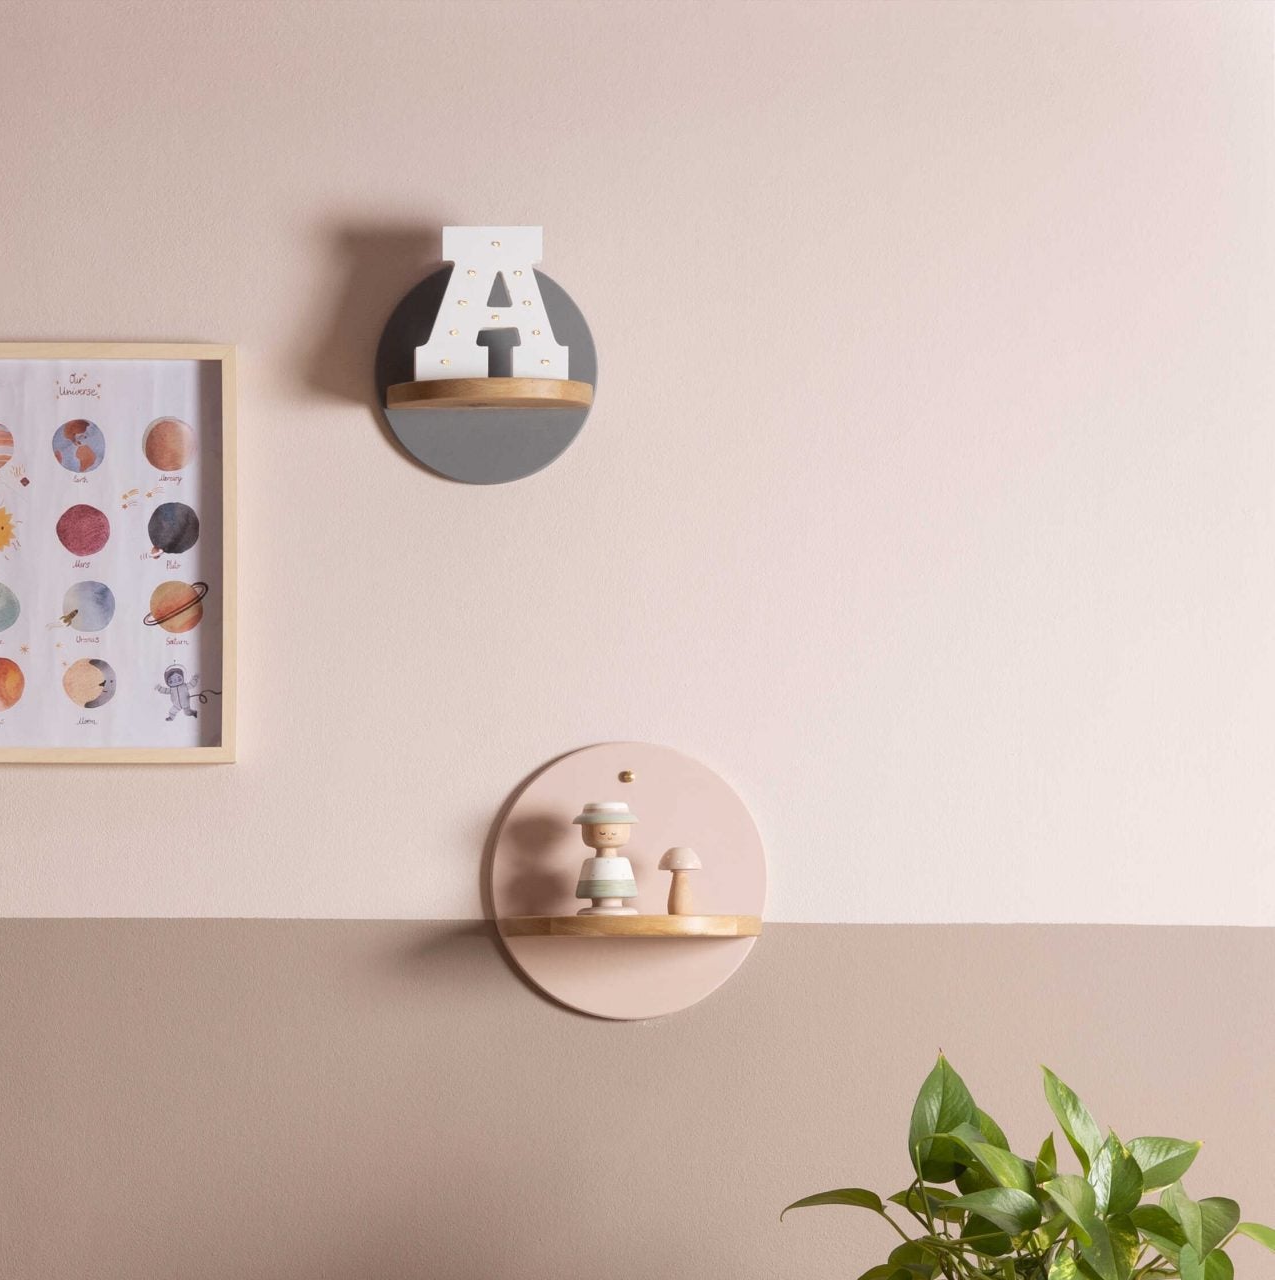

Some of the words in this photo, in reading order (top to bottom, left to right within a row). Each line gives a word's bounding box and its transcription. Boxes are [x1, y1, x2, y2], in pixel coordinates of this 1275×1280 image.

[414, 226, 569, 381] A
[69, 372, 86, 384] Our
[59, 386, 98, 397] Universe
[72, 560, 91, 569] Mars
[165, 636, 190, 646] Saturn
